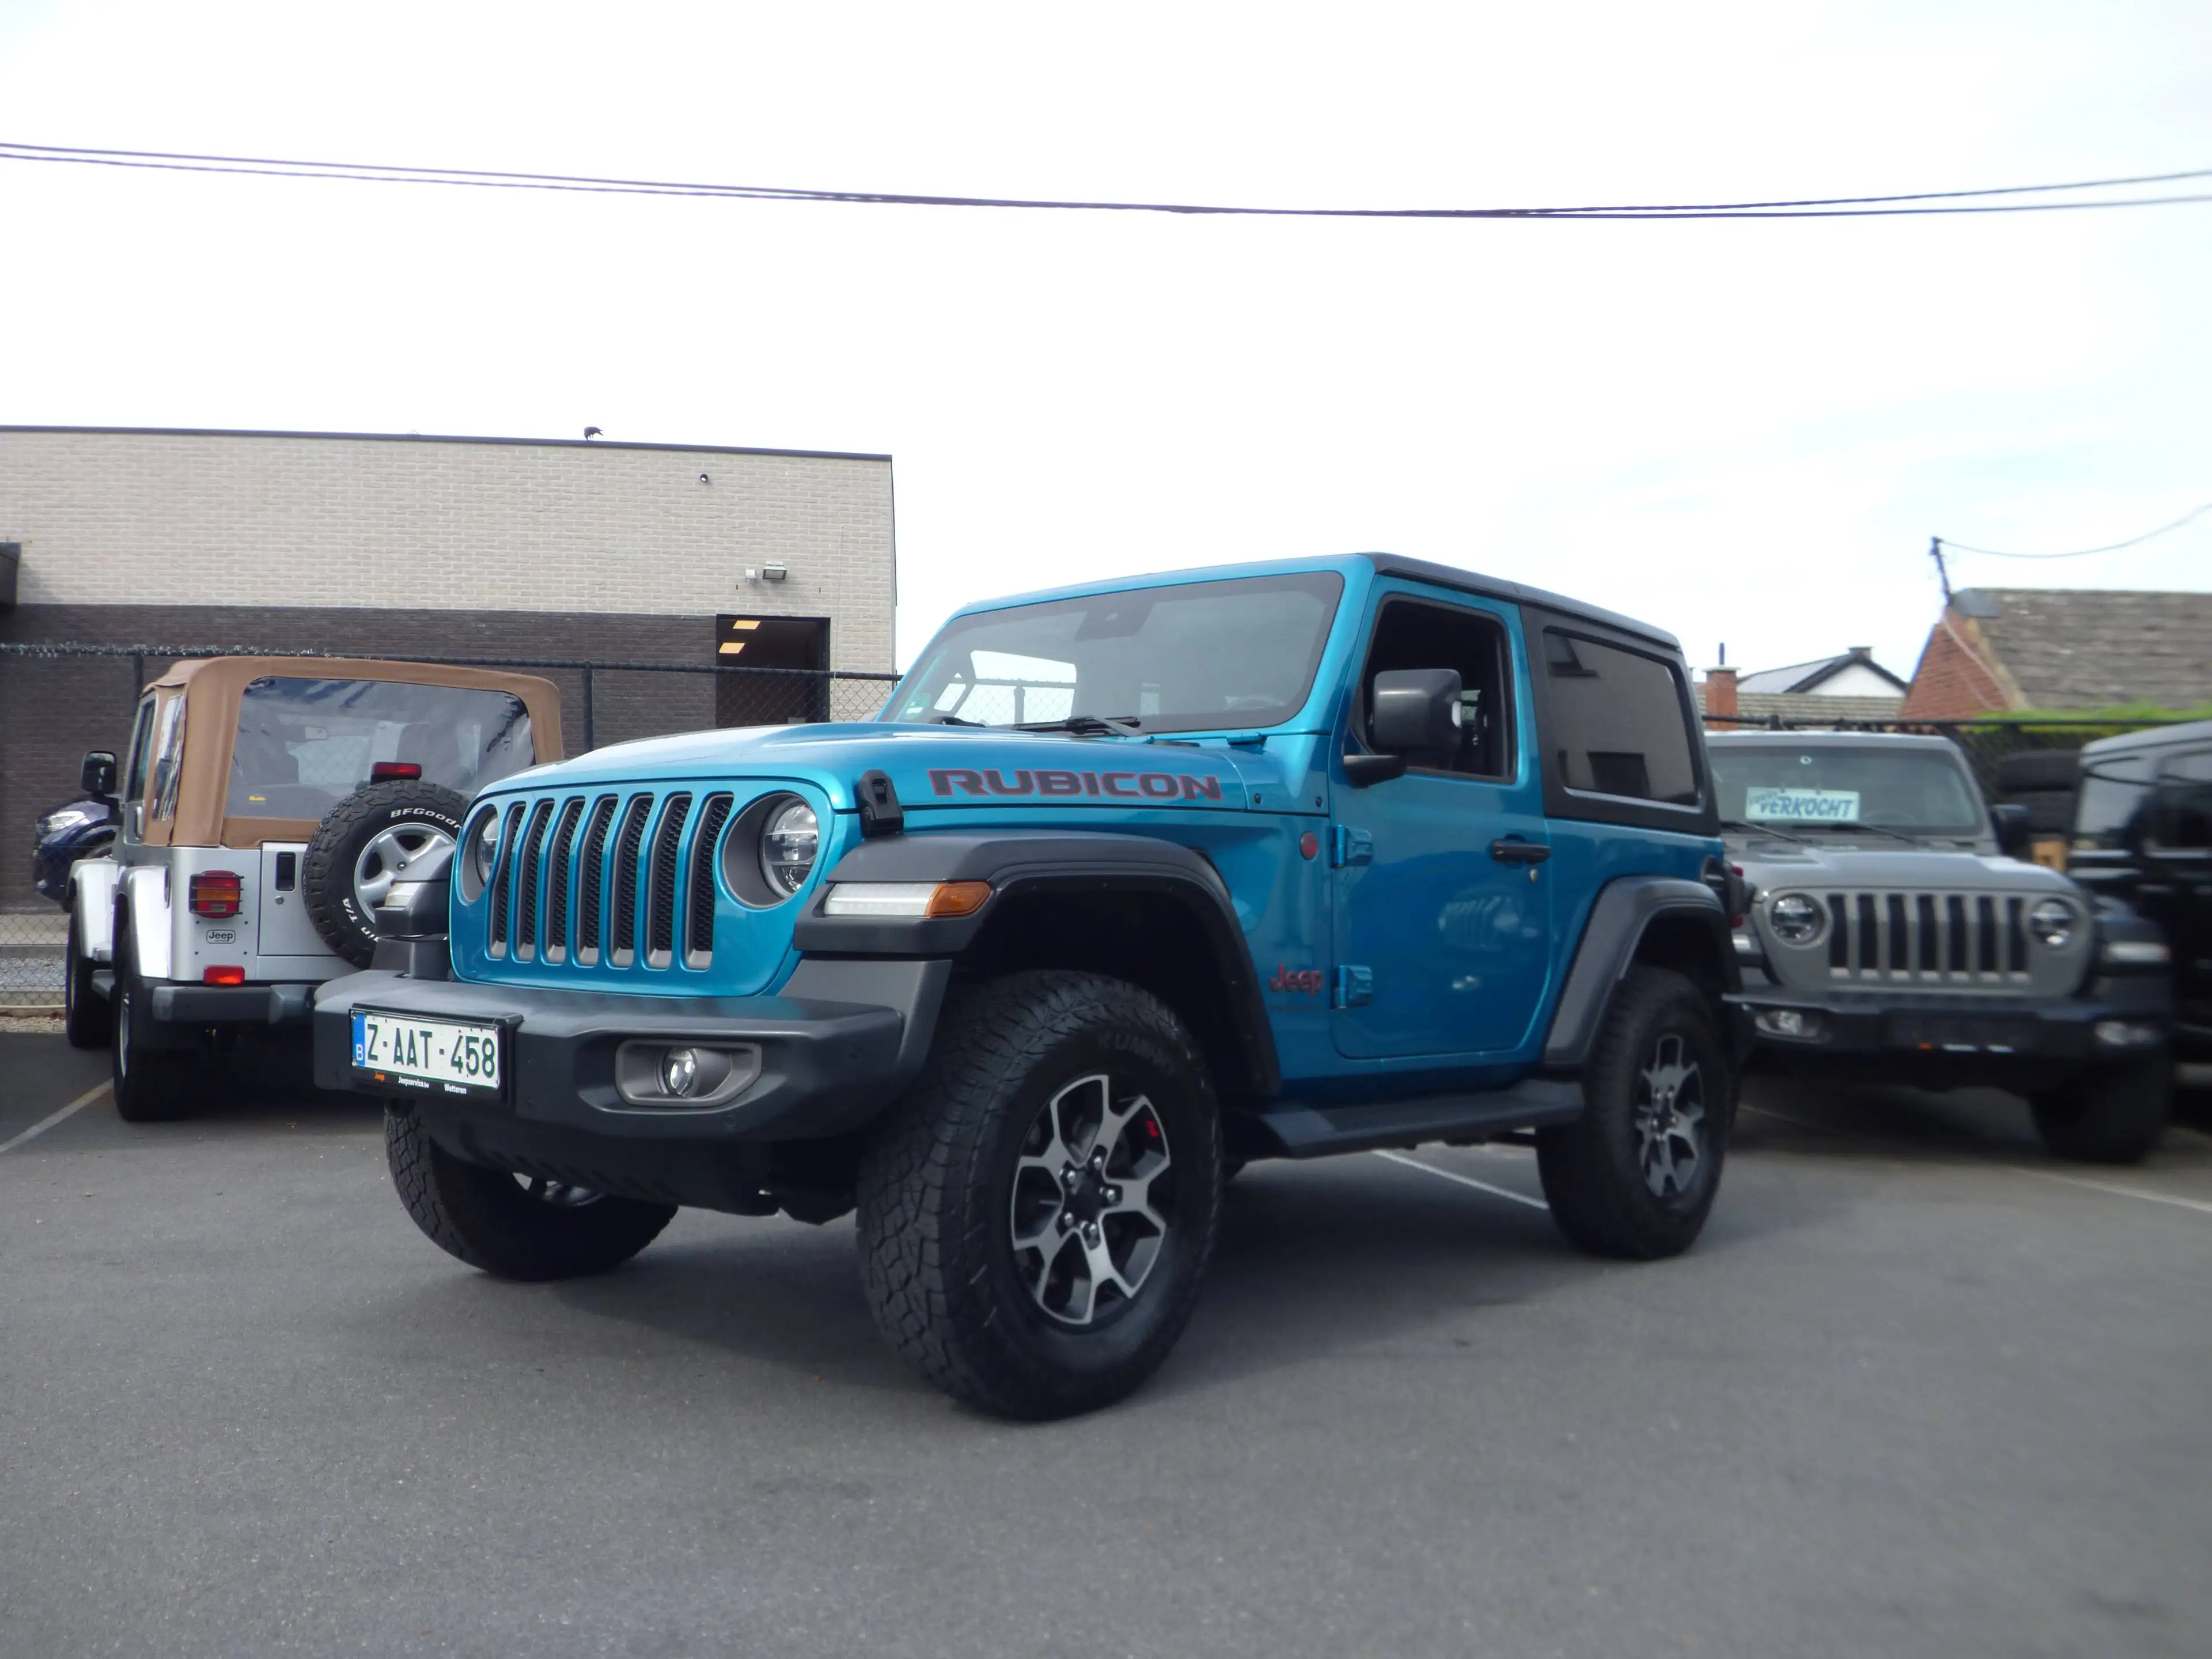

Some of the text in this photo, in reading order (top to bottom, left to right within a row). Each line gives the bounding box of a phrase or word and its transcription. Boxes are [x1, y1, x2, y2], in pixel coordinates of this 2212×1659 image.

[927, 769, 1222, 800] RUBICON
[1760, 796, 1853, 817] VERKOCHT
[209, 931, 233, 942] Jeep
[1269, 963, 1323, 997] Jeep
[355, 1044, 363, 1060] B
